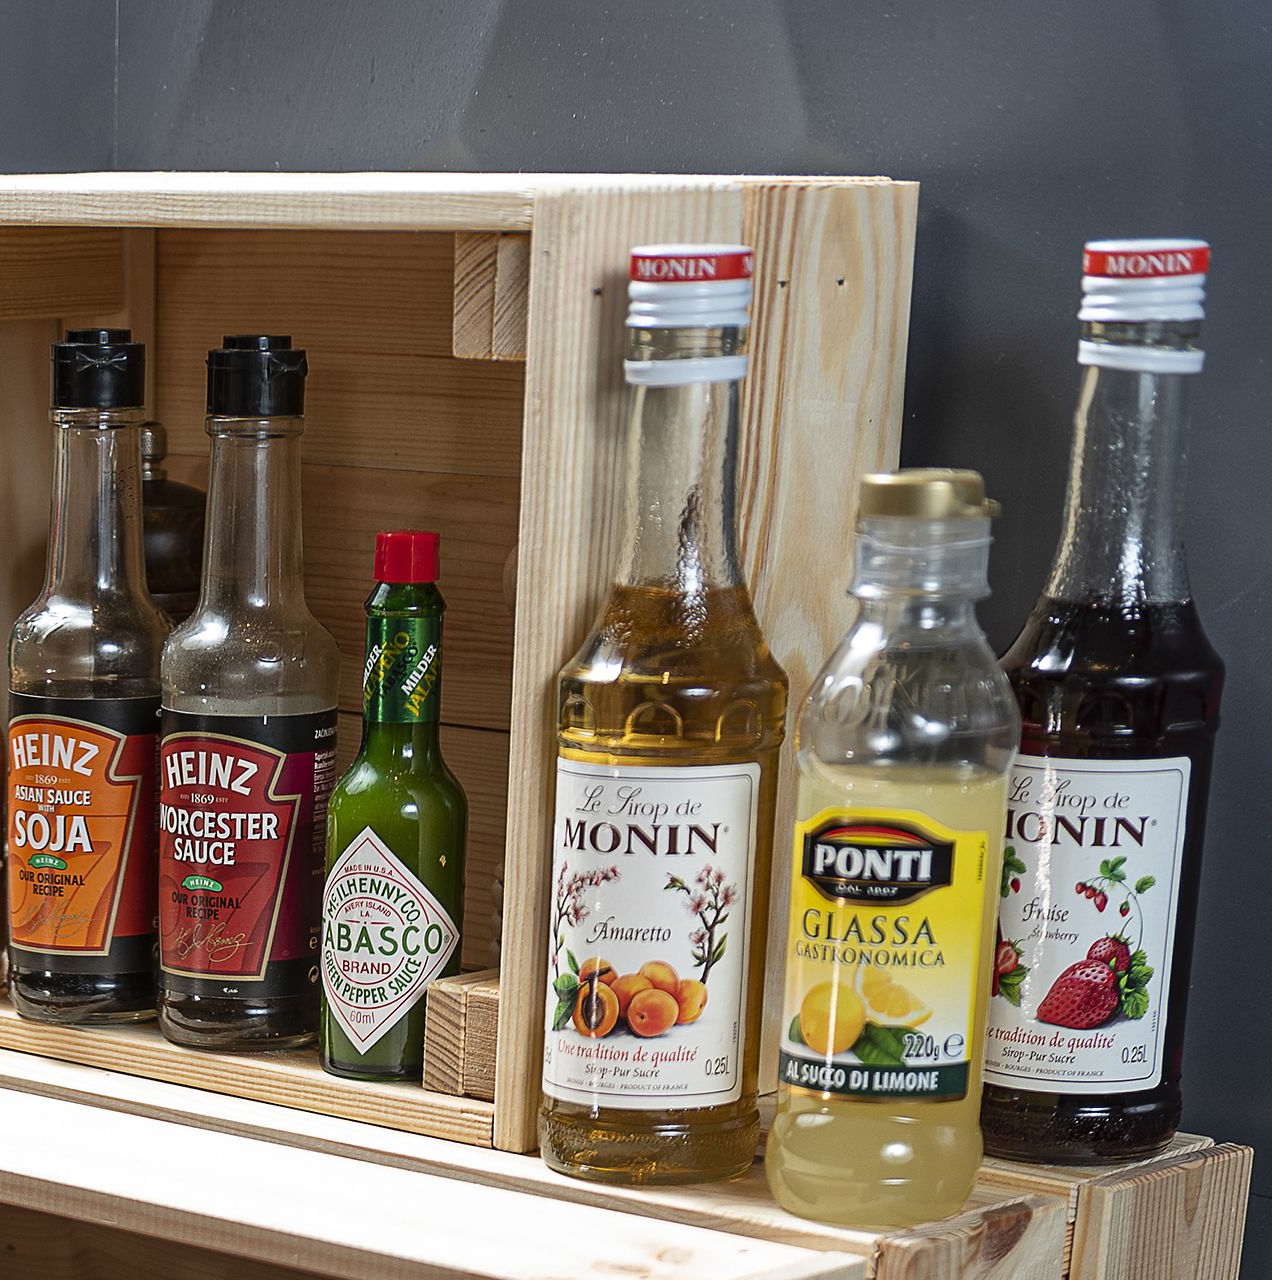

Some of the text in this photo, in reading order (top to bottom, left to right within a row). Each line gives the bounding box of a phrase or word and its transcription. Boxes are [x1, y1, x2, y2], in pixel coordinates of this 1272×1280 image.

[636, 258, 716, 279] MONIN
[1106, 253, 1192, 275] MONIN
[401, 644, 437, 696] MILDER
[12, 733, 100, 777] HEINZ
[35, 774, 58, 785] 1869
[166, 751, 258, 796] HEINZ
[15, 784, 91, 805] ASIAN SAUCE
[191, 792, 215, 804] 1869
[1008, 776, 1033, 803] Le
[1104, 793, 1130, 809] de
[38, 804, 55, 812] WITH
[576, 785, 702, 824] Le Sirop de
[15, 810, 93, 853] SOJA
[563, 817, 722, 855] MONIN
[35, 857, 60, 866] HEINZ
[174, 837, 235, 866] SAUCE
[813, 843, 933, 882] PONTI
[19, 869, 85, 886] OUR ORIGINAL
[344, 864, 363, 873] MADE
[373, 865, 395, 877] U.S.A.
[33, 884, 64, 897] RECIPE
[189, 878, 215, 888] HEINZ
[171, 891, 242, 909] OUR ORIGINAL
[344, 901, 392, 917] AVERY ISLAND
[1022, 897, 1069, 922] Fraise
[186, 906, 220, 920] RECIPE
[360, 910, 372, 918] LA.
[323, 917, 443, 956] ABASCO
[586, 916, 671, 944] Amaretto
[802, 908, 938, 946] GLASSA
[1028, 924, 1079, 945] Stwberry
[794, 940, 946, 968] GASTRONOMICA
[325, 950, 422, 1005] GREEN PEPPER SAUCE
[342, 959, 392, 975] BRAND
[349, 1010, 376, 1024] 60ml
[903, 1033, 940, 1061] 220g
[995, 1028, 1046, 1048] tradition
[1049, 1031, 1064, 1048] de
[1068, 1032, 1116, 1054] qualité
[558, 1039, 576, 1055] Une
[576, 1043, 629, 1062] tradition
[632, 1045, 648, 1062] de
[651, 1044, 699, 1068] qualité
[1048, 1051, 1076, 1064] Sucre
[1122, 1043, 1148, 1065] 0.25L
[632, 1065, 661, 1079] Sucre
[704, 1055, 730, 1077] 0.25L
[786, 1060, 940, 1092] AL SUCCO DI LIMONE
[1035, 1067, 1066, 1076] PRODUCT
[1077, 1069, 1104, 1077] FRANCE
[589, 1081, 616, 1090] BURGES
[619, 1083, 652, 1091] PRODUCT
[662, 1083, 689, 1091] FRANCE
